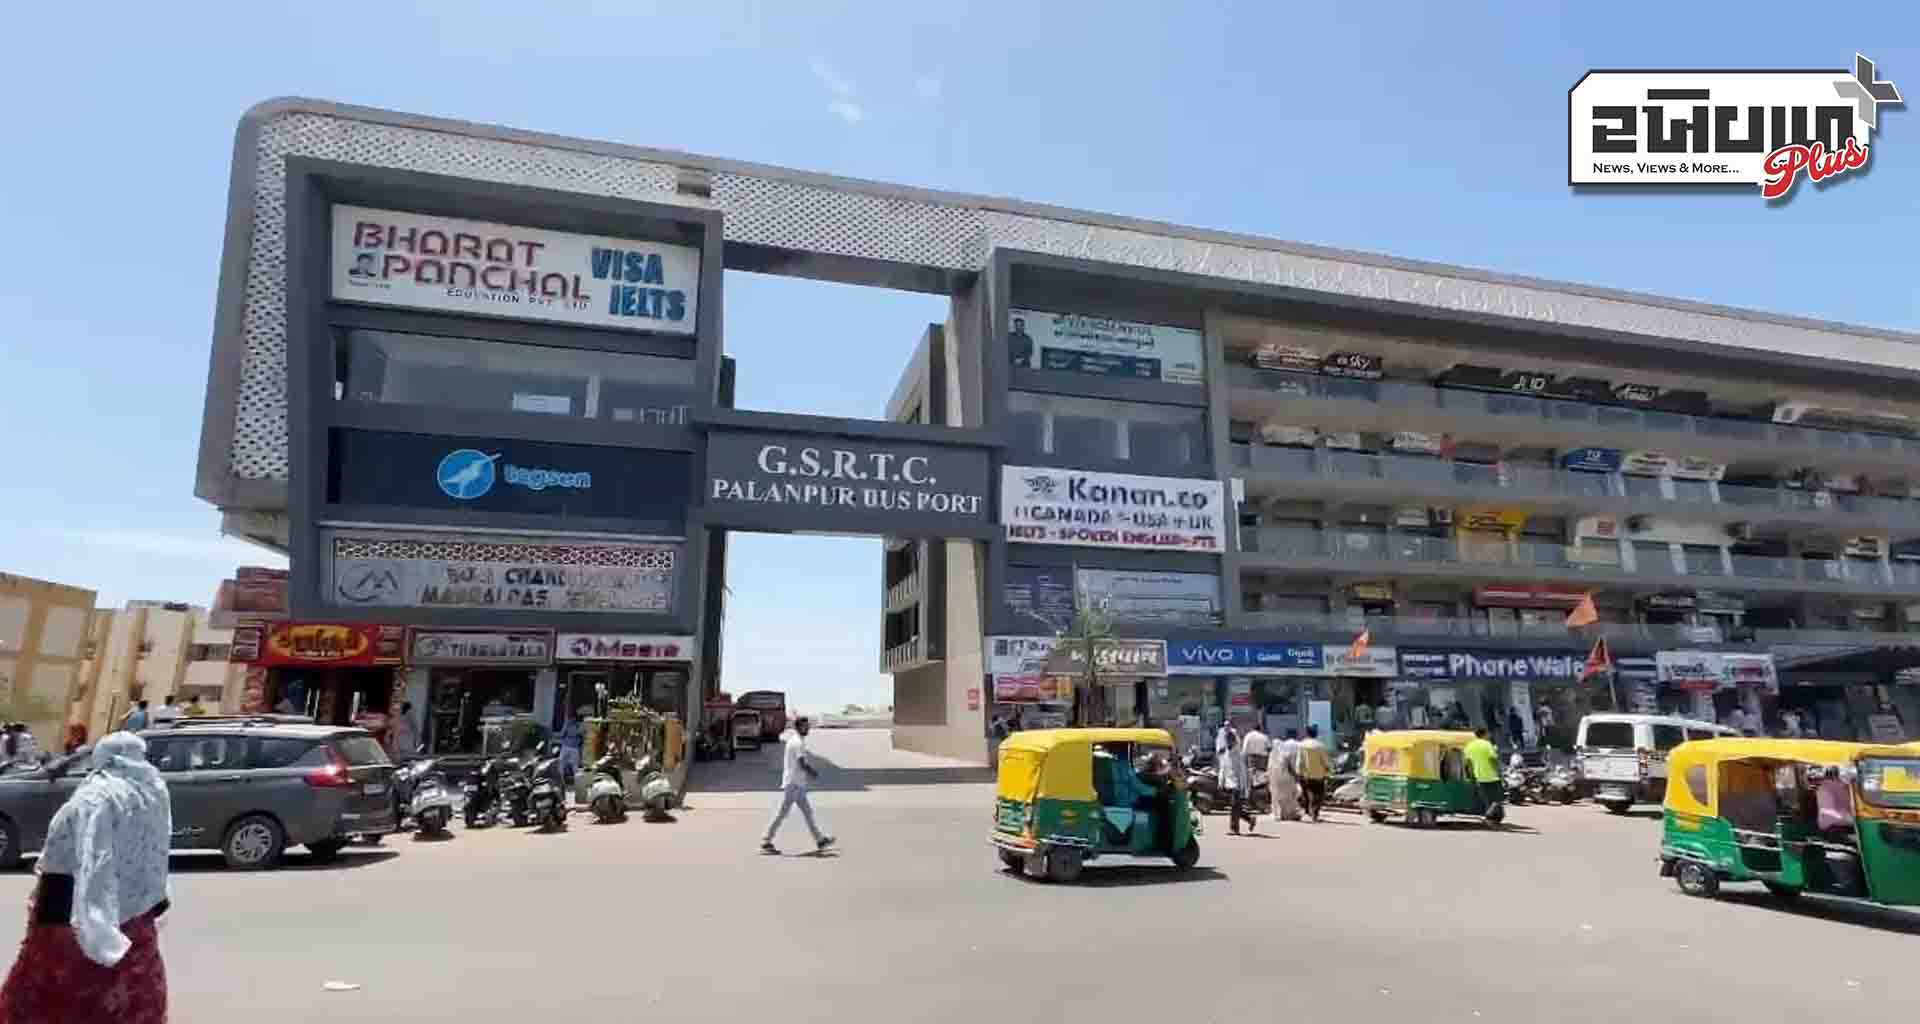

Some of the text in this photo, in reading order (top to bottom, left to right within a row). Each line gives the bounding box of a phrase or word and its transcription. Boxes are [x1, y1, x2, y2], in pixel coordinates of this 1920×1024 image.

[353, 221, 544, 267] BHARAT
[382, 254, 590, 299] PANCHAL
[591, 247, 665, 285] VISA
[609, 284, 687, 321] IELTS
[758, 444, 937, 485] G.S.R.T.C.
[712, 479, 982, 514] PALANPUR BUS PORT
[1069, 476, 1209, 510] Kanan.co
[1060, 526, 1120, 543] SPOKEN
[1133, 513, 1169, 530] USA
[1189, 516, 1214, 531] UK
[1182, 645, 1234, 663] vivo
